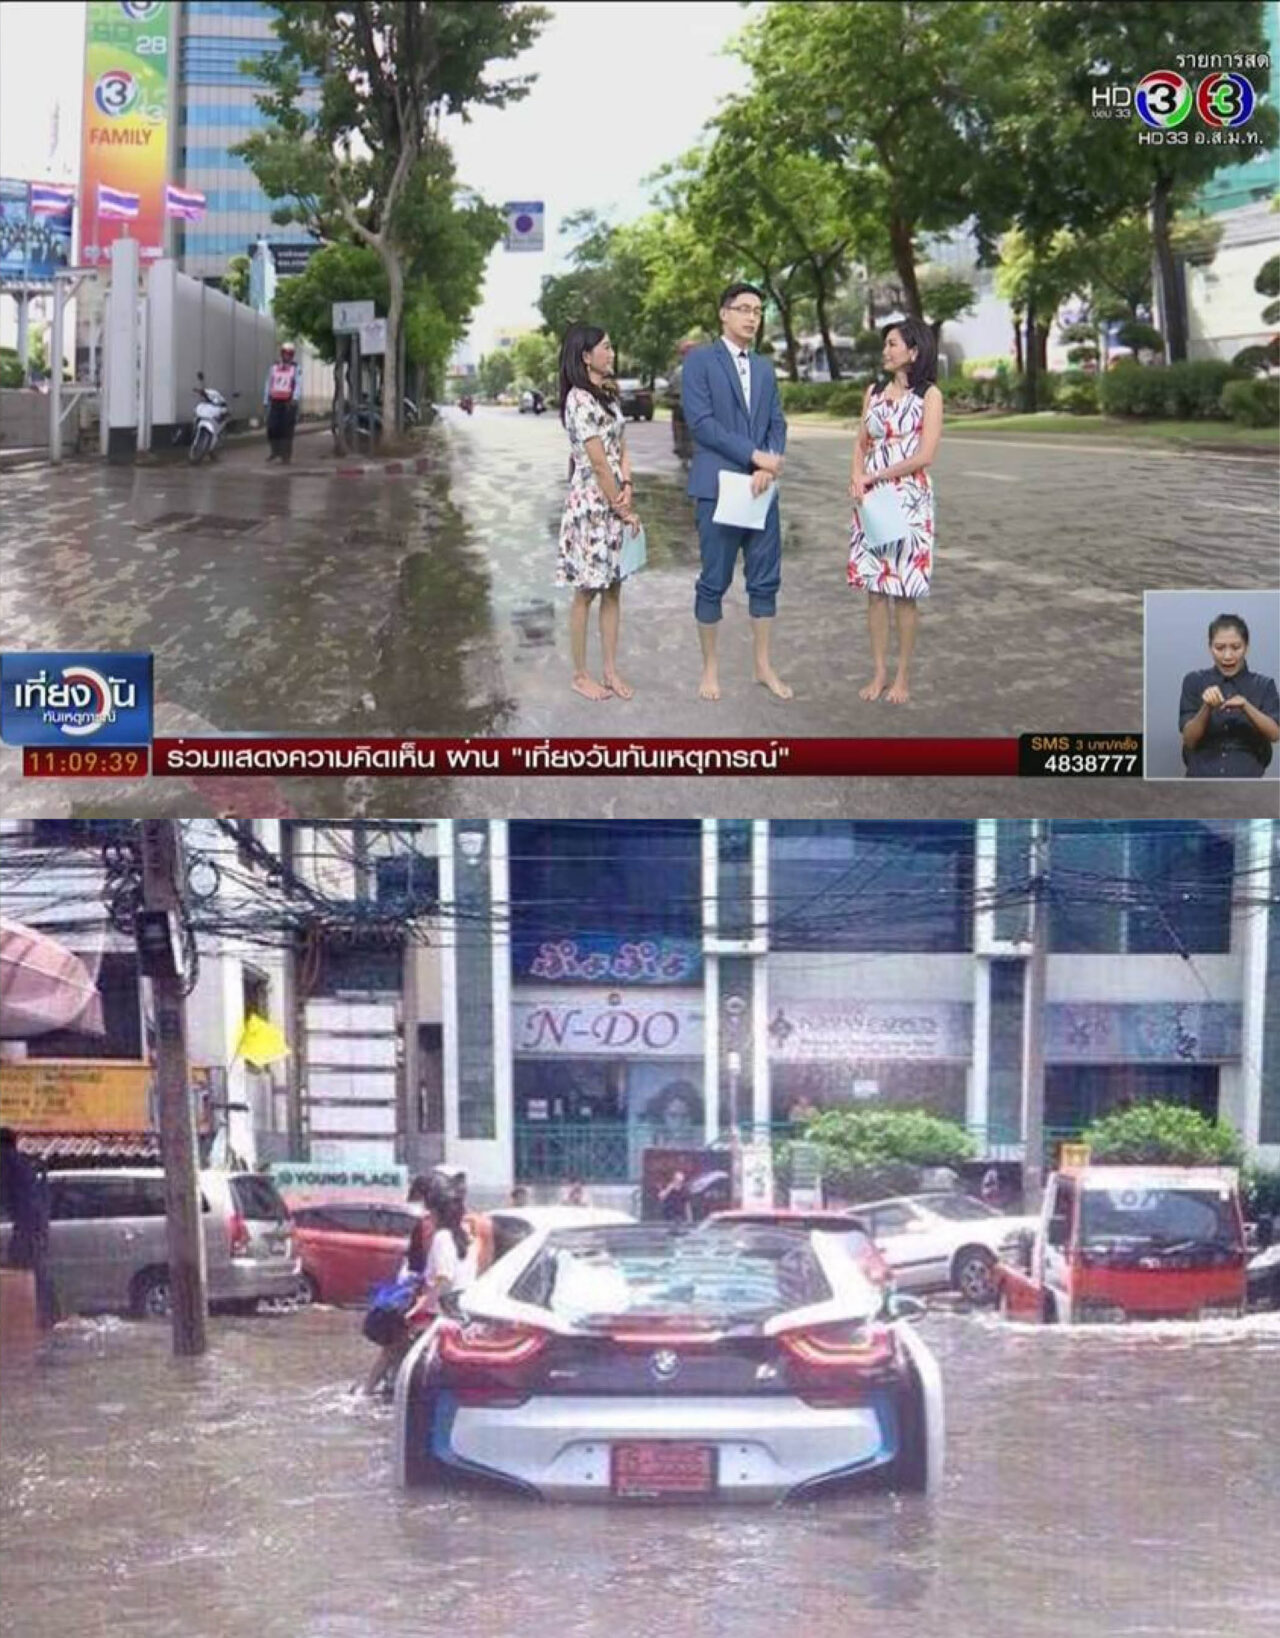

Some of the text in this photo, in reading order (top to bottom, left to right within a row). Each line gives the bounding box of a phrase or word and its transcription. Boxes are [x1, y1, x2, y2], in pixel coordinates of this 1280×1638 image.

[136, 35, 167, 55] 28
[89, 128, 152, 145] FAMILY
[523, 1008, 680, 1049] N-DO
[295, 1171, 401, 1187] YOUNG PLACE
